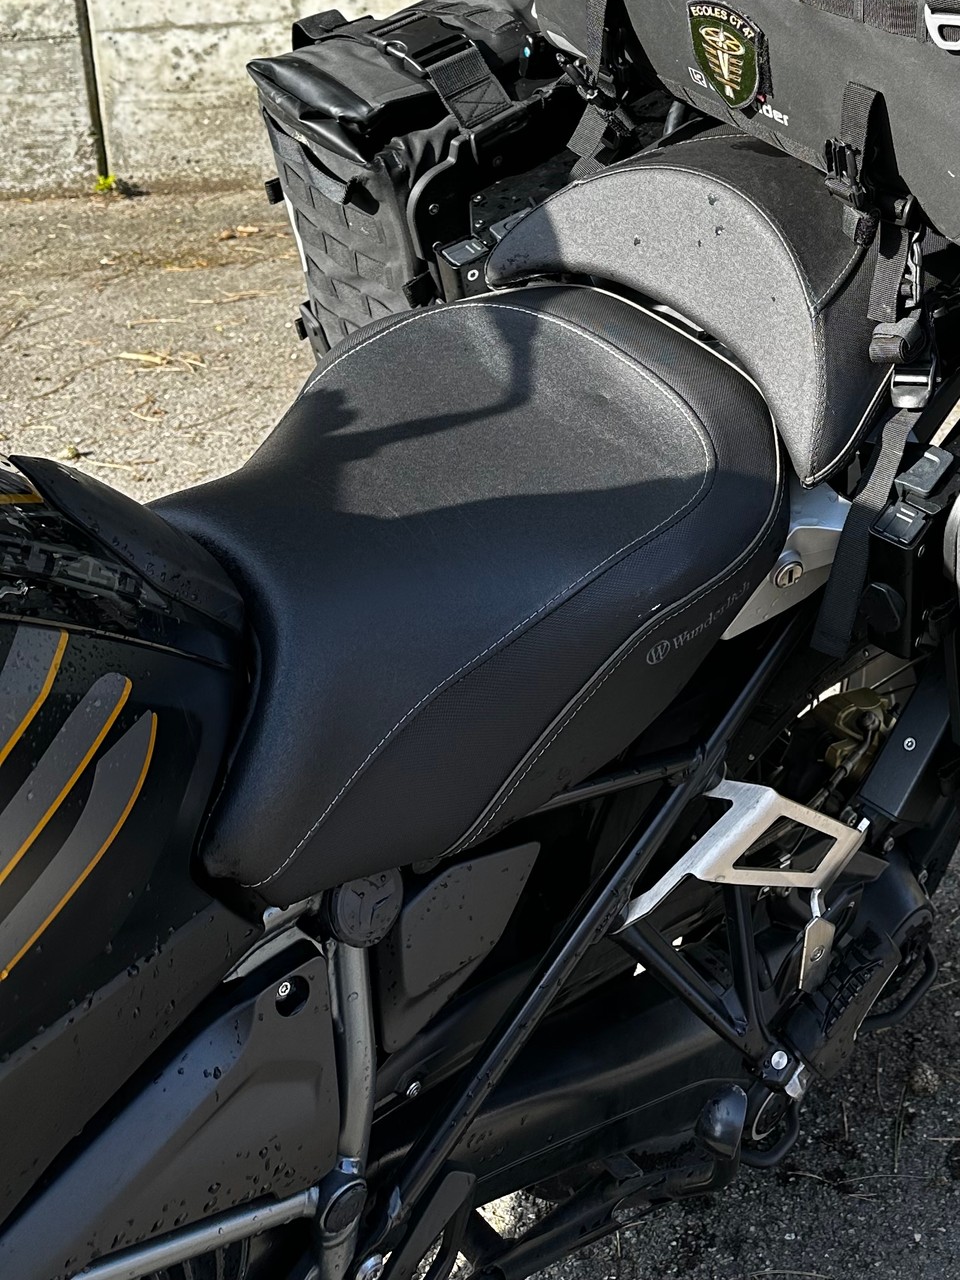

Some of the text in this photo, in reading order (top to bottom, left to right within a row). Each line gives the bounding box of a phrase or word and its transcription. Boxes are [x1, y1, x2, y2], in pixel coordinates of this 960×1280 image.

[690, 6, 755, 39] ECOLES CT 47
[758, 103, 789, 126] der
[673, 581, 750, 649] Wunderlich
